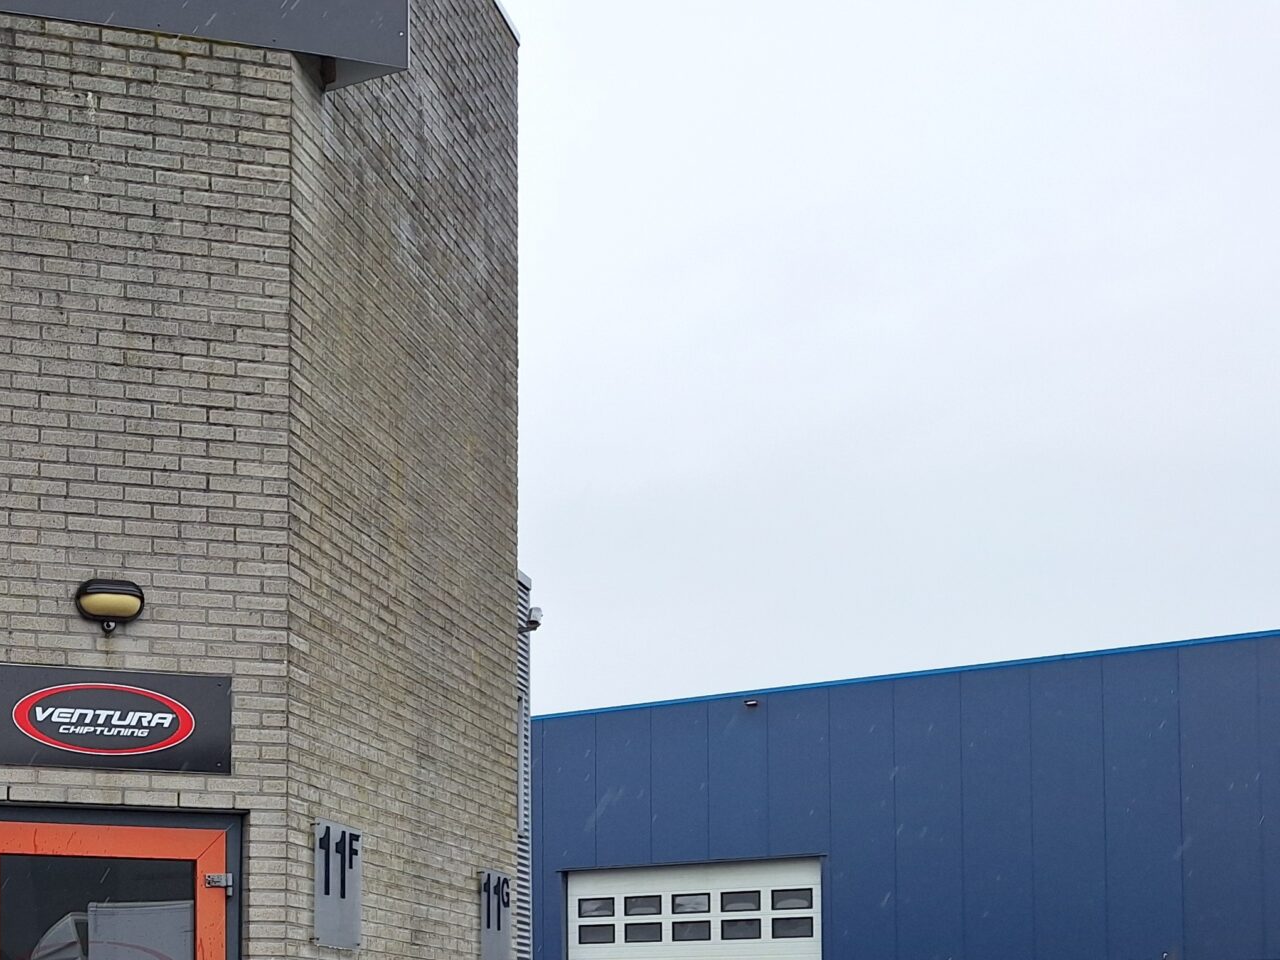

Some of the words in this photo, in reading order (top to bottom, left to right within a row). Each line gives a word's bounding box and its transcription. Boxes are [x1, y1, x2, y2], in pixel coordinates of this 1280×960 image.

[35, 706, 174, 728] VENTURA
[59, 725, 149, 737] CHIPTUNING
[320, 826, 360, 899] 11F
[484, 873, 510, 931] 11G
